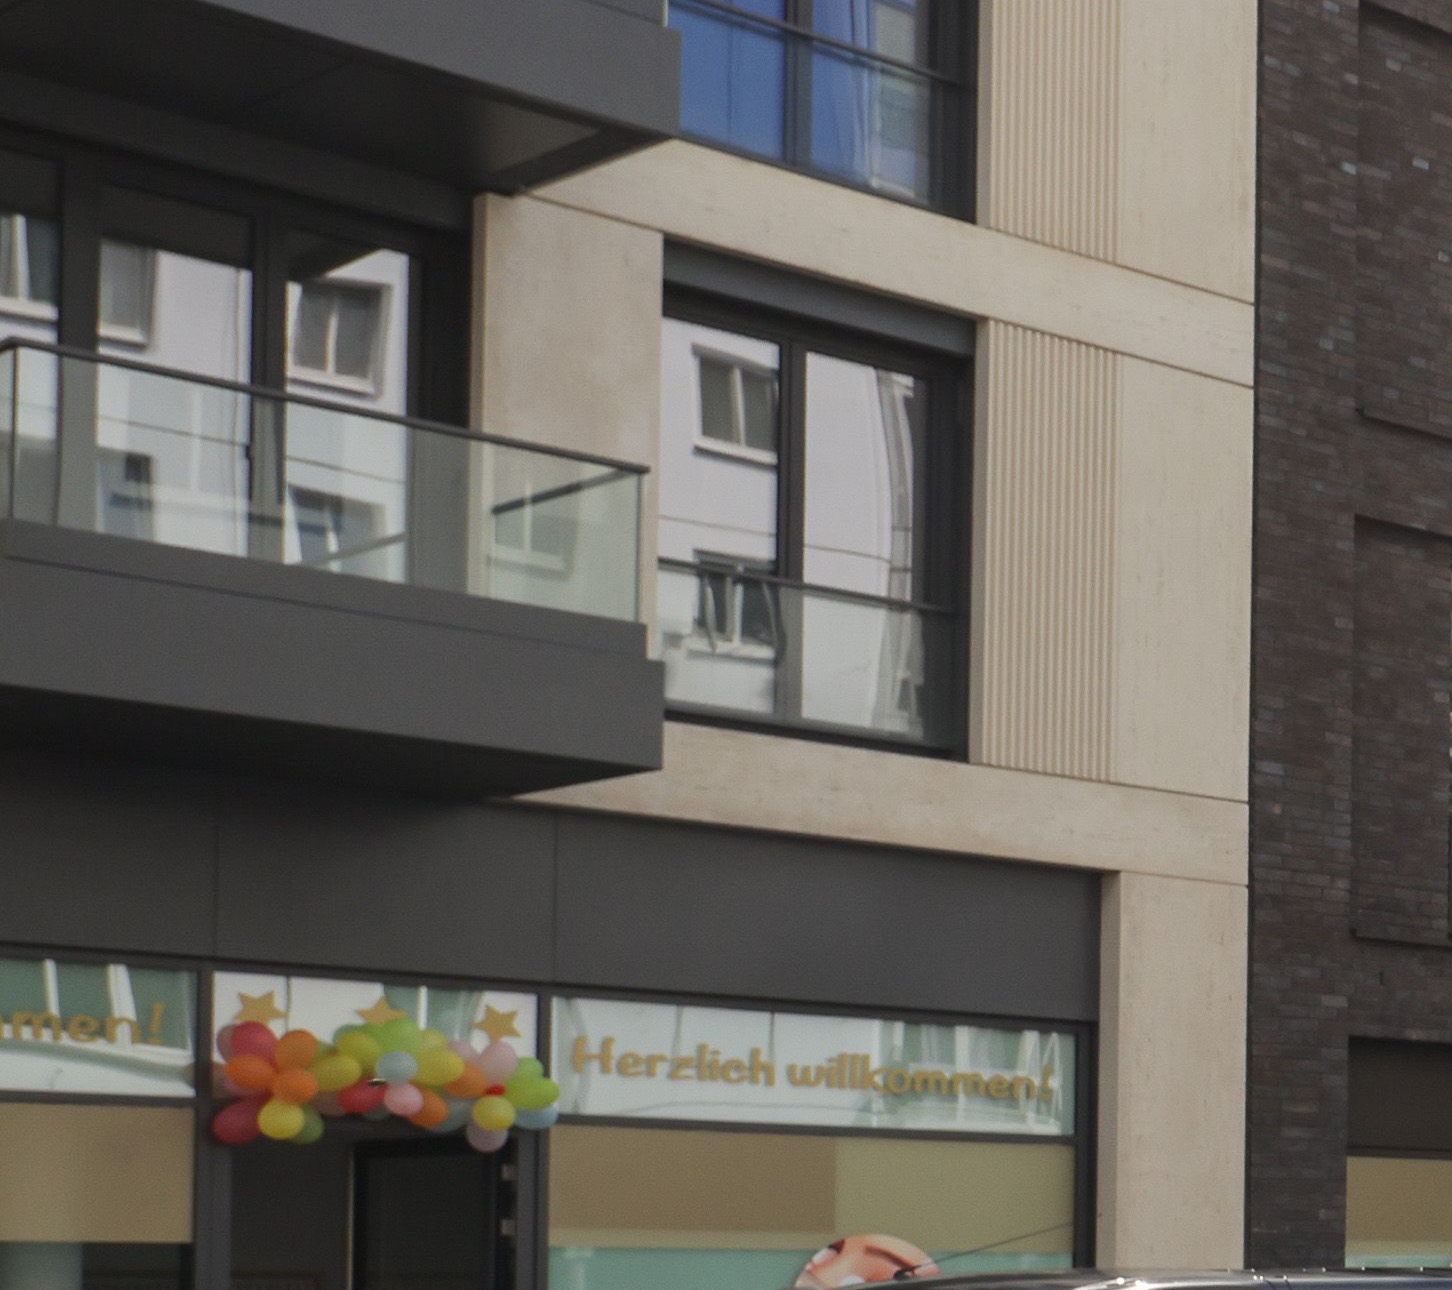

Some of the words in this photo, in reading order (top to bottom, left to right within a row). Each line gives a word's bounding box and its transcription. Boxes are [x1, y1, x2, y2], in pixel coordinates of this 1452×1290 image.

[0, 1001, 166, 1046] men!
[571, 1035, 775, 1087] Herzlich
[786, 1051, 1056, 1102] willkommen!
